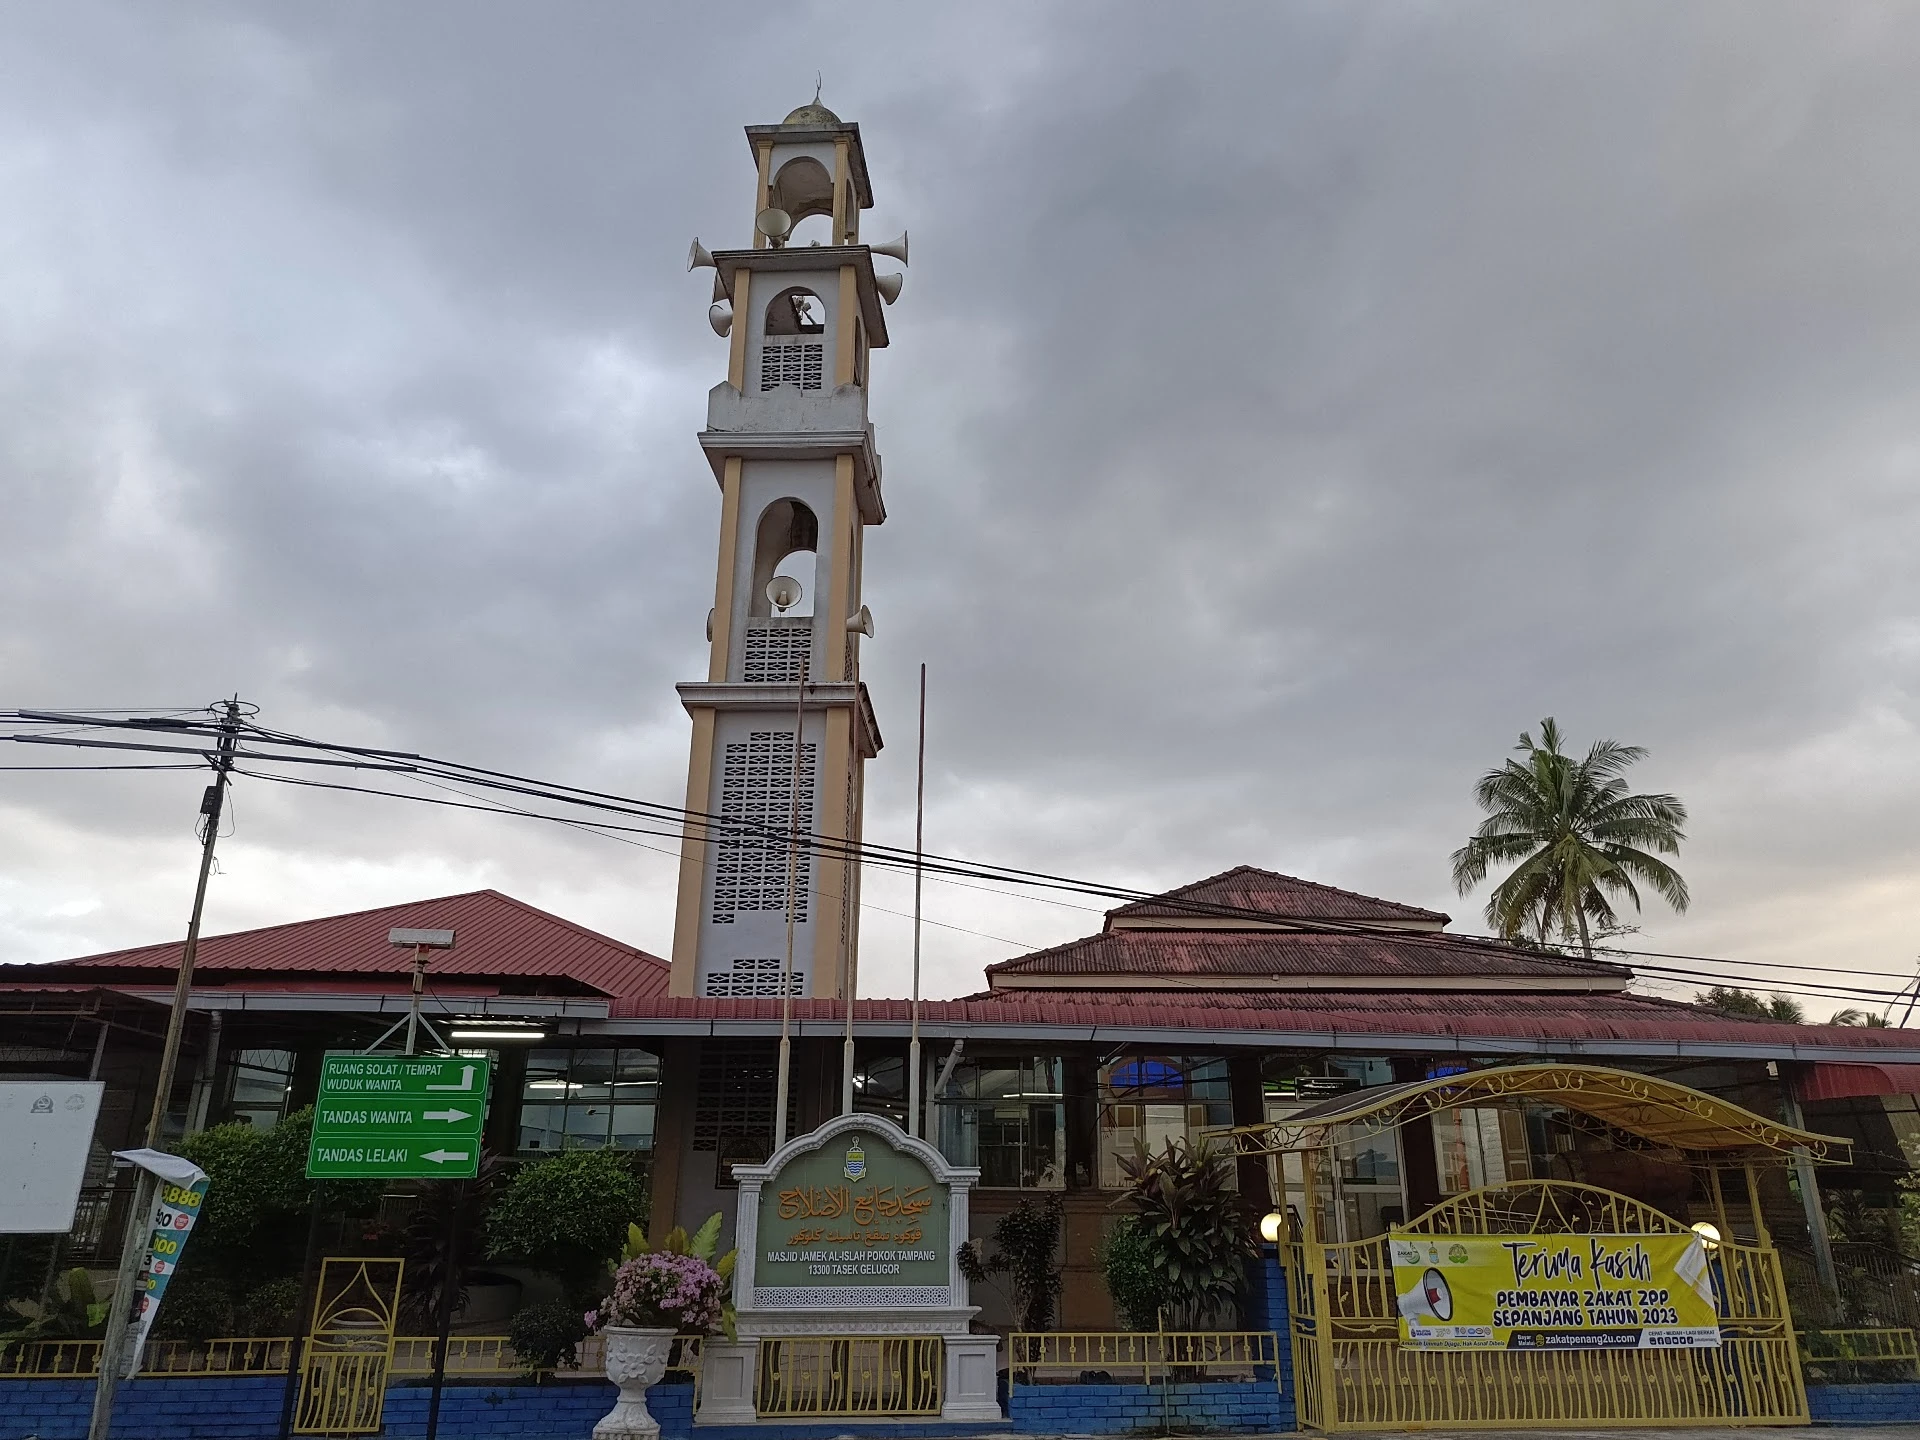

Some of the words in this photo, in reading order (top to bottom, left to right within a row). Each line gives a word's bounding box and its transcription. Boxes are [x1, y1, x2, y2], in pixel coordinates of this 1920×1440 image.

[329, 1063, 364, 1075] RUANG
[366, 1064, 399, 1076] SOLAT
[406, 1064, 443, 1076] TEMPAT
[327, 1079, 363, 1090] WUDUK
[366, 1080, 402, 1091] WANITA
[323, 1110, 367, 1124] TANDAS
[370, 1111, 413, 1124] WANITA
[317, 1148, 364, 1162] TANDAS
[366, 1149, 408, 1162] LELAKI
[767, 1251, 798, 1262] MASJID
[799, 1251, 828, 1262] JAMEK
[828, 1250, 866, 1261] AL-ISLAH
[867, 1250, 896, 1261] POKOK
[897, 1250, 936, 1261] TAMPANG
[808, 1264, 831, 1275] 13300
[832, 1264, 859, 1275] TASEK
[860, 1264, 900, 1275] GELUGOR
[1501, 1242, 1582, 1288] Terima
[1589, 1238, 1651, 1291] Kasih
[1496, 1290, 1579, 1308] PEMBAYAR
[1583, 1290, 1632, 1307] ZAKAT
[1637, 1289, 1669, 1306] ZPP
[1493, 1308, 1583, 1327] SEPANJANG
[1587, 1307, 1638, 1326] TAHUN
[1642, 1307, 1679, 1325] 2023
[1545, 1334, 1635, 1346] zakatpenang2u.com
